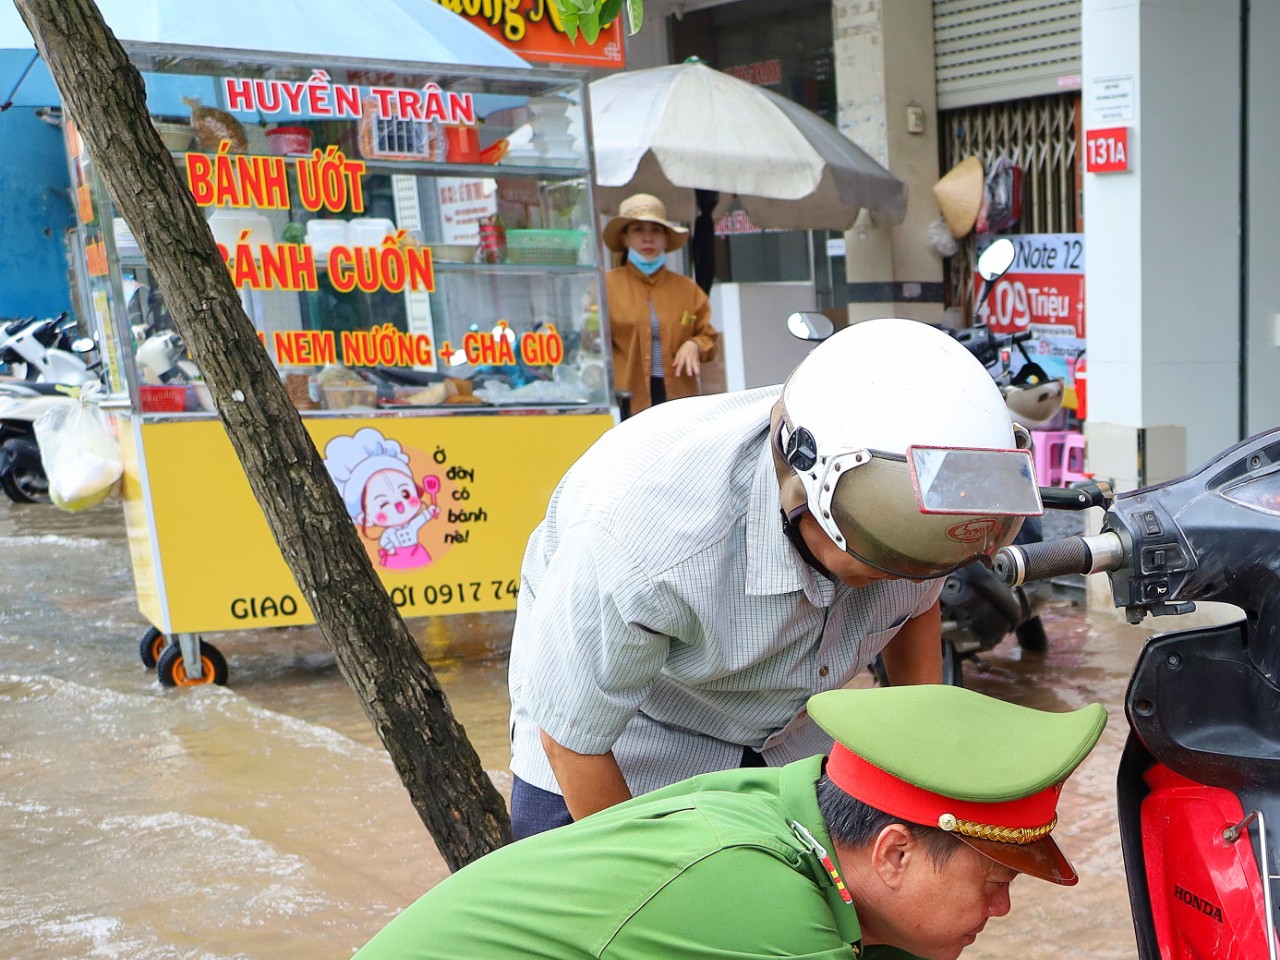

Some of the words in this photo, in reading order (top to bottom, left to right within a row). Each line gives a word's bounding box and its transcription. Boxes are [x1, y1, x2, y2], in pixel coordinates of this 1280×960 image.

[224, 69, 363, 119] HUYỀN
[371, 82, 476, 125] TRÂN
[1087, 138, 1126, 165] 131A
[186, 139, 290, 210] BÁNH
[297, 145, 366, 212] ƯỚT
[329, 230, 436, 293] CUỐN
[1016, 241, 1058, 270] Note
[1064, 240, 1084, 269] 12
[1028, 286, 1070, 323] Triệu
[275, 330, 337, 365] NEM
[342, 323, 434, 366] NƯỚNG
[463, 320, 516, 366] CHẢ
[520, 324, 564, 366] GIÒ
[447, 507, 487, 523] bánh
[230, 594, 298, 619] GIAO
[390, 584, 415, 608] ƠI
[424, 582, 482, 605] 0917
[491, 579, 519, 600] 74
[1174, 884, 1224, 924] HONDA
